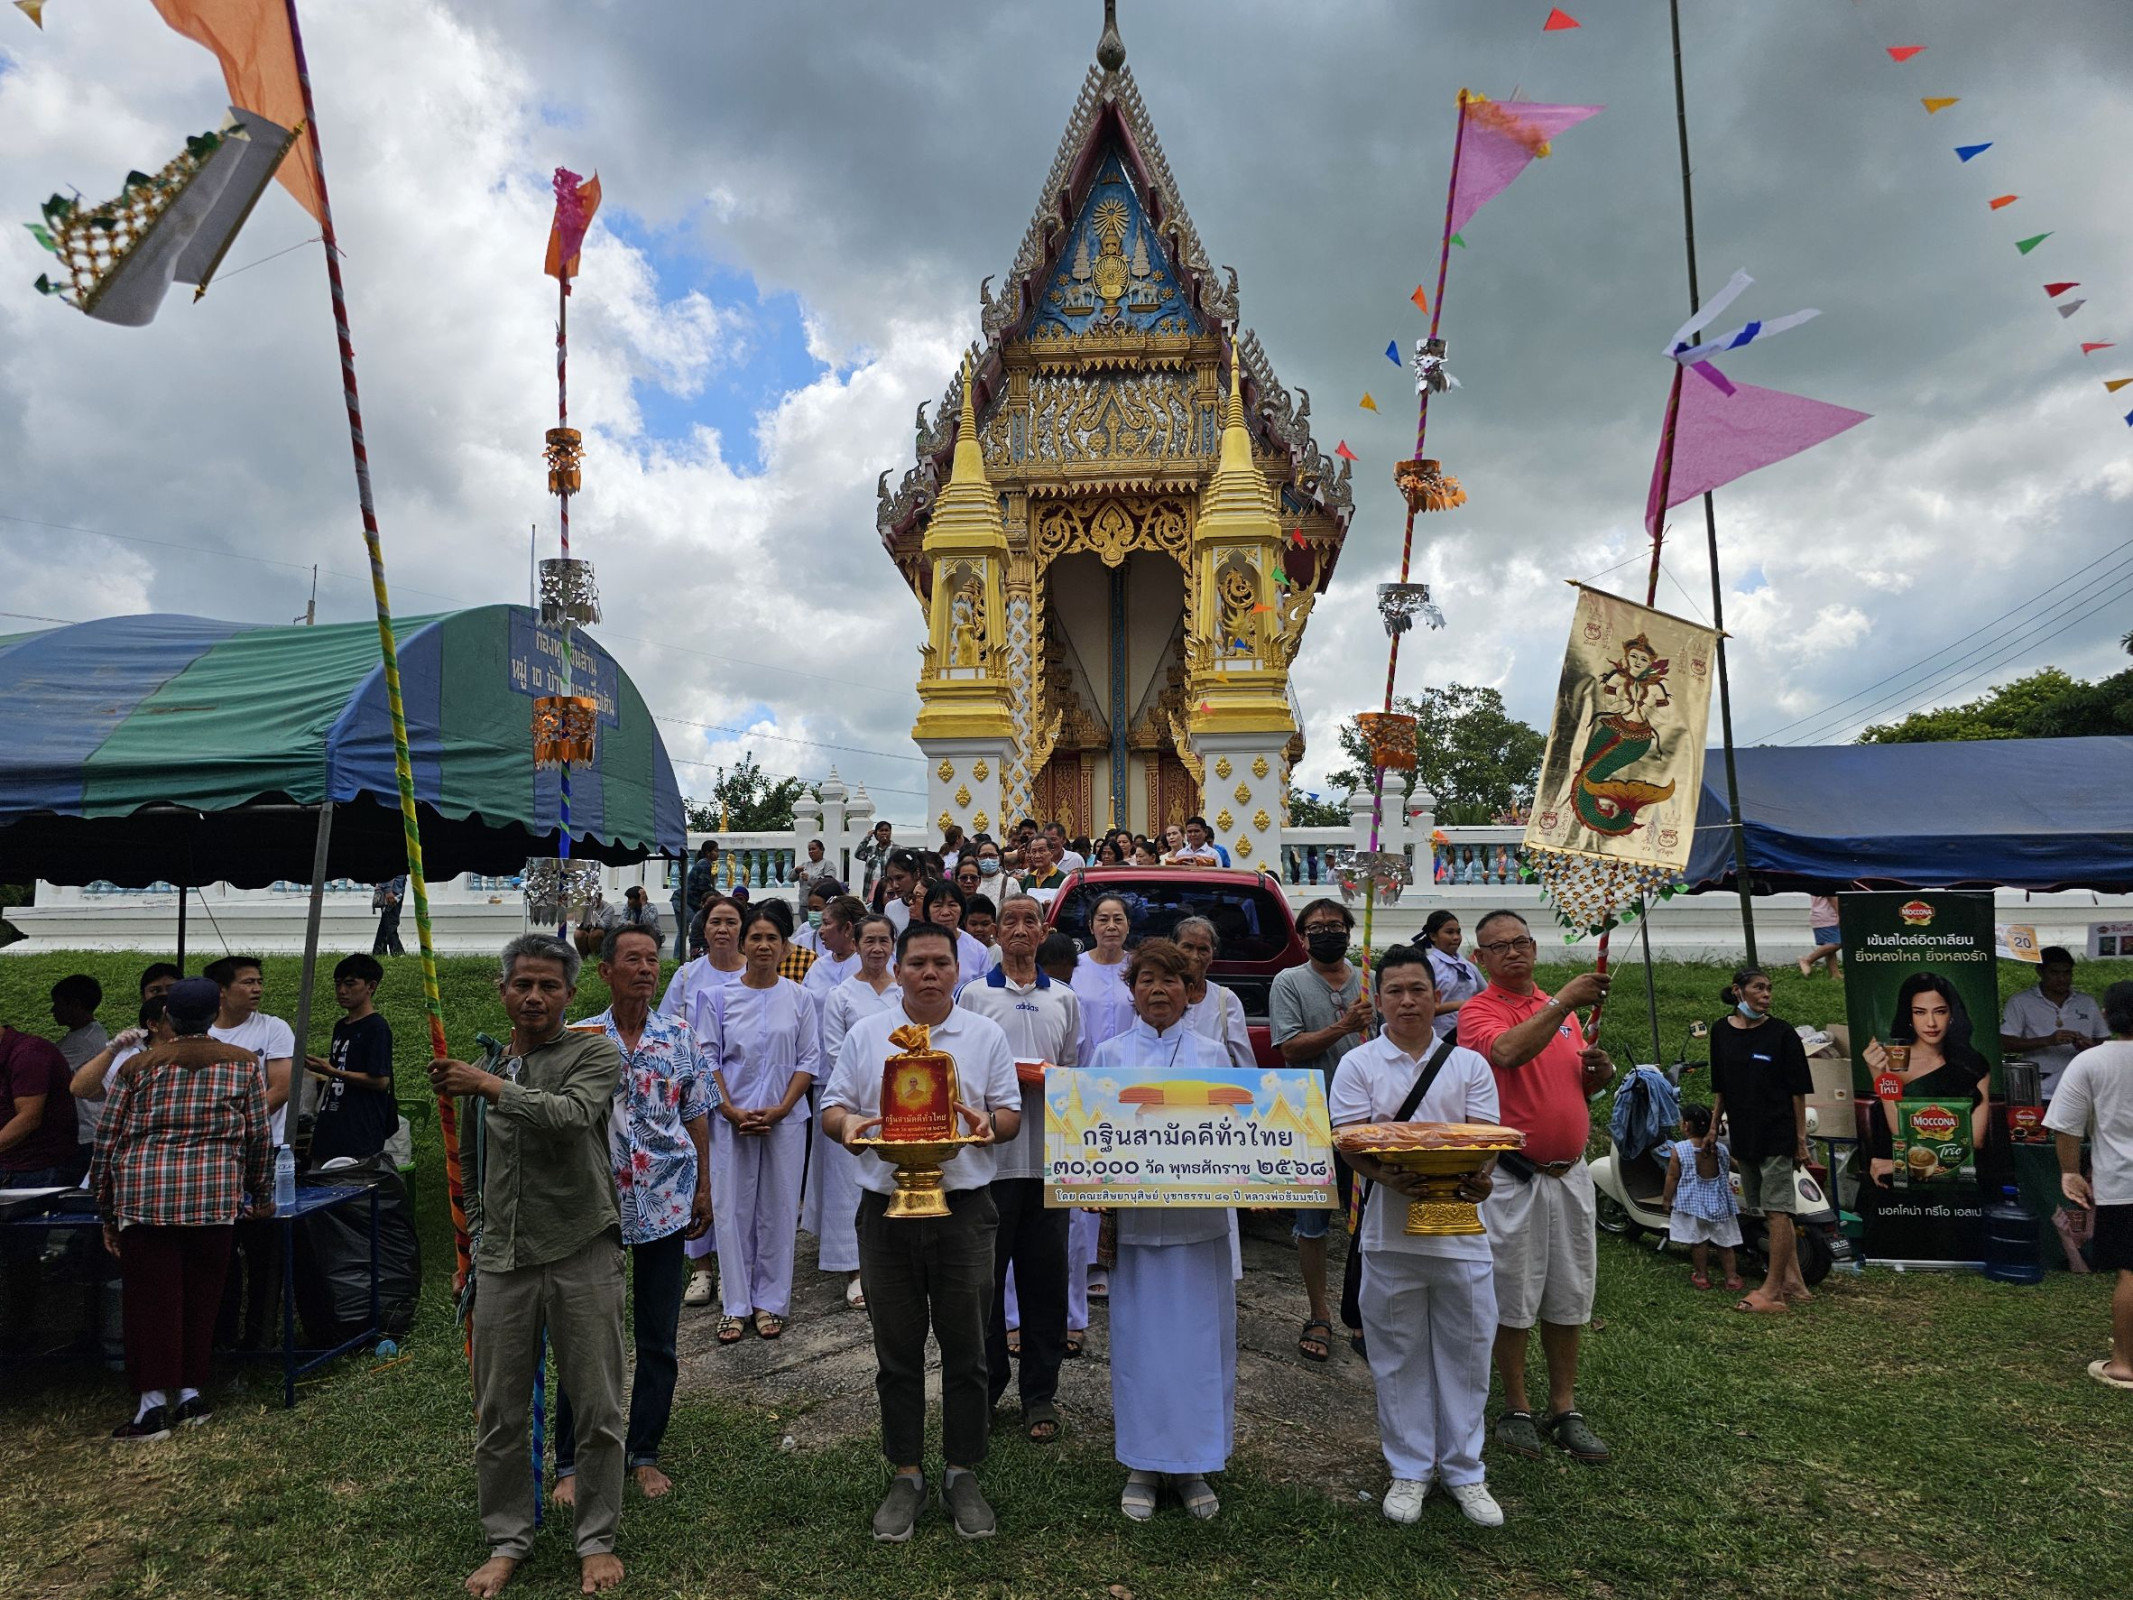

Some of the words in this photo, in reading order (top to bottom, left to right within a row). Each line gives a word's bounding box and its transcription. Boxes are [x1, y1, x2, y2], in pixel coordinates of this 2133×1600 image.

[512, 655, 527, 690] หมู่
[1867, 932, 1974, 946] เข้มสไตล์อิตาเลียน
[2014, 936, 2031, 949] 20
[1926, 948, 1988, 962] ยิ่งหลงรัก
[1015, 1002, 1039, 1013] adidas
[1913, 1116, 1956, 1126] MOCCONA
[1083, 1116, 1293, 1153] กฐินสามัคคีทั่วไทย
[1936, 1143, 1962, 1159] Trio
[1053, 1159, 1139, 1178] ๓๐,๐๐๐
[1145, 1159, 1165, 1175] วัด
[1170, 1159, 1251, 1181] พุทธศักราช
[1257, 1158, 1327, 1178] ๒๕๖๘
[1056, 1189, 1076, 1201] โดย
[1163, 1190, 1211, 1204] บูชาธรรม
[1233, 1190, 1241, 1201] ปี
[1878, 1204, 1922, 1216] มอคโคน่า
[1925, 1205, 1951, 1217] ทรีโอ
[1954, 1208, 1982, 1217] เอสเป
